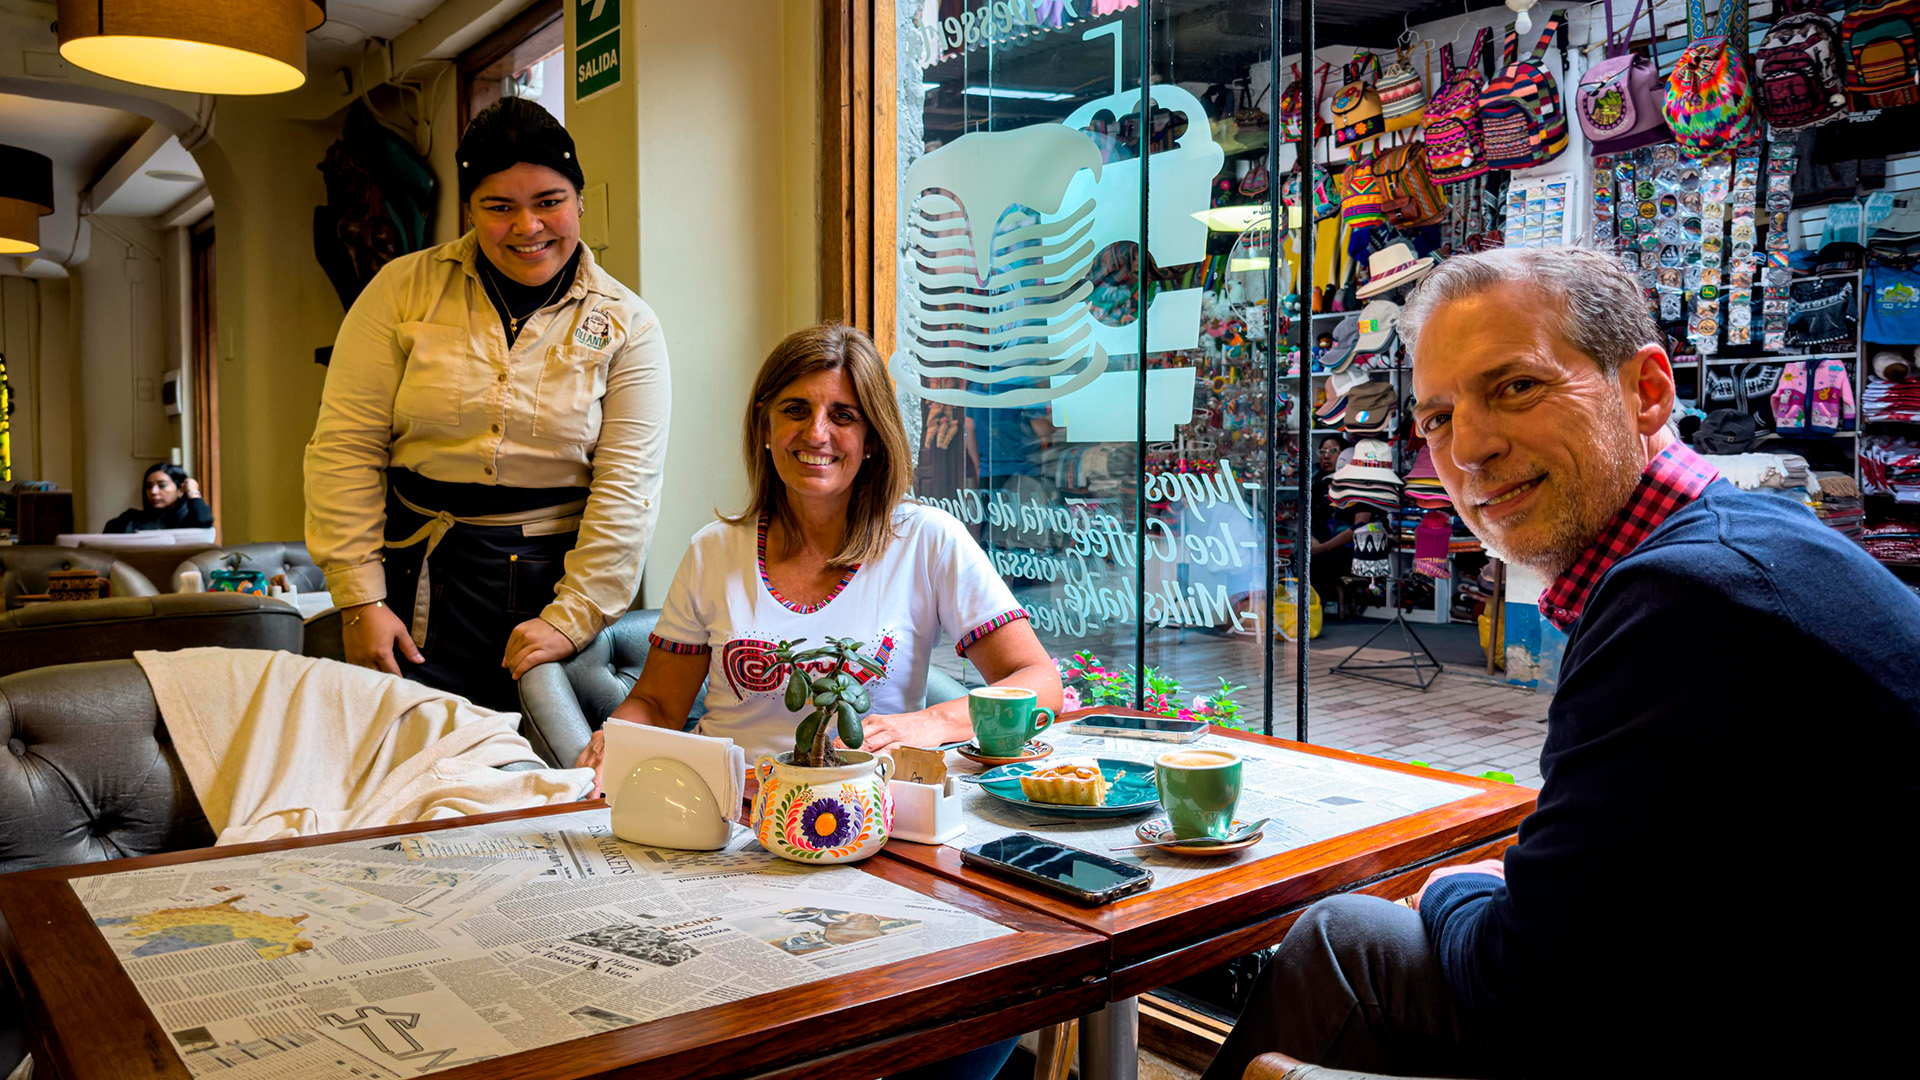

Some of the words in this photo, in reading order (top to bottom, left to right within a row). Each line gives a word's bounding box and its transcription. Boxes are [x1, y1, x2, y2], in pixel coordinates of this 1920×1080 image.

[578, 48, 618, 83] SALIDA
[661, 917, 722, 932] RACING
[312, 978, 334, 986] up
[337, 973, 358, 981] for
[361, 956, 452, 976] Tiananmen
[543, 951, 583, 966] Tested
[604, 967, 633, 980] Vote
[556, 945, 602, 962] Reform
[603, 958, 643, 972] Plans
